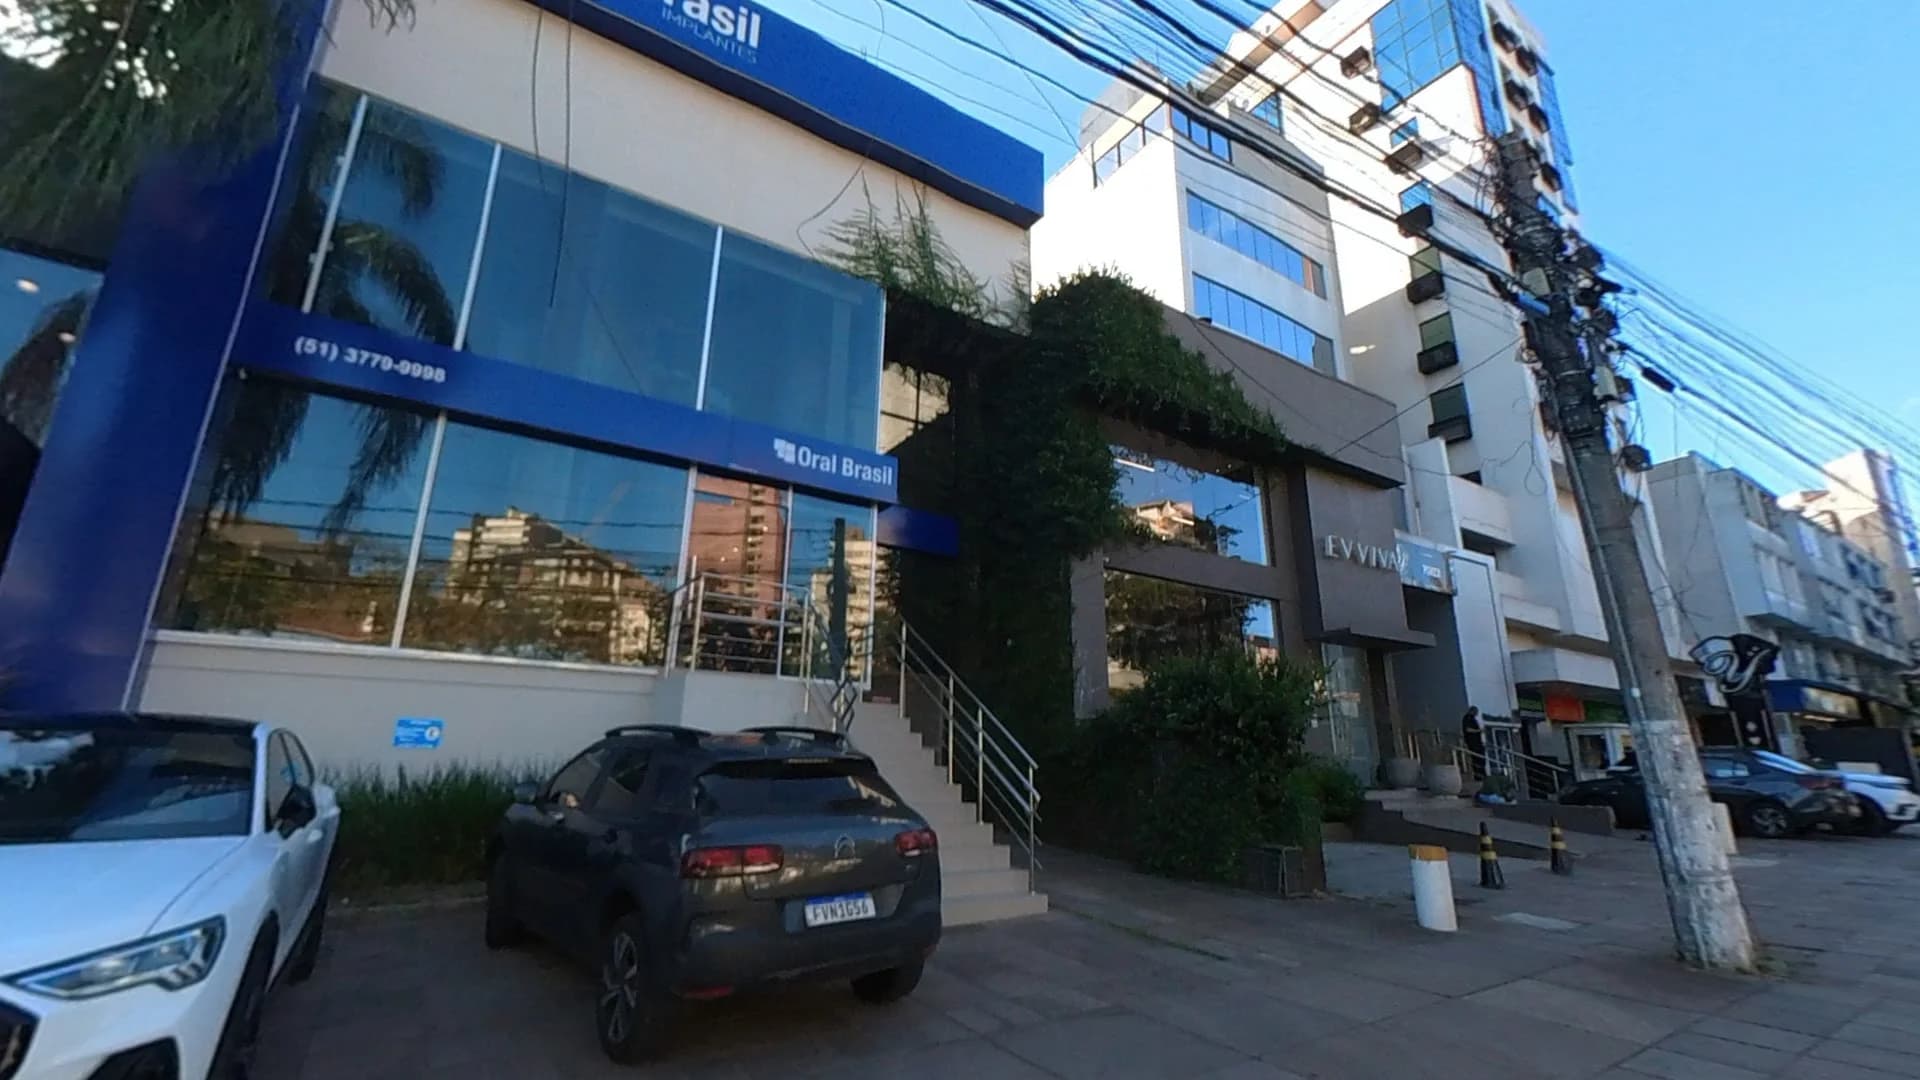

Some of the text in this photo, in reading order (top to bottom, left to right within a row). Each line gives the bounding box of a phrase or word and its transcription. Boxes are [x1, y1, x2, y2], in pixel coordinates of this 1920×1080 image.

[661, 6, 758, 64] IMPLANTES
[663, 0, 761, 49] asil
[294, 335, 339, 362] (51)
[798, 446, 893, 486] Oral Brasil
